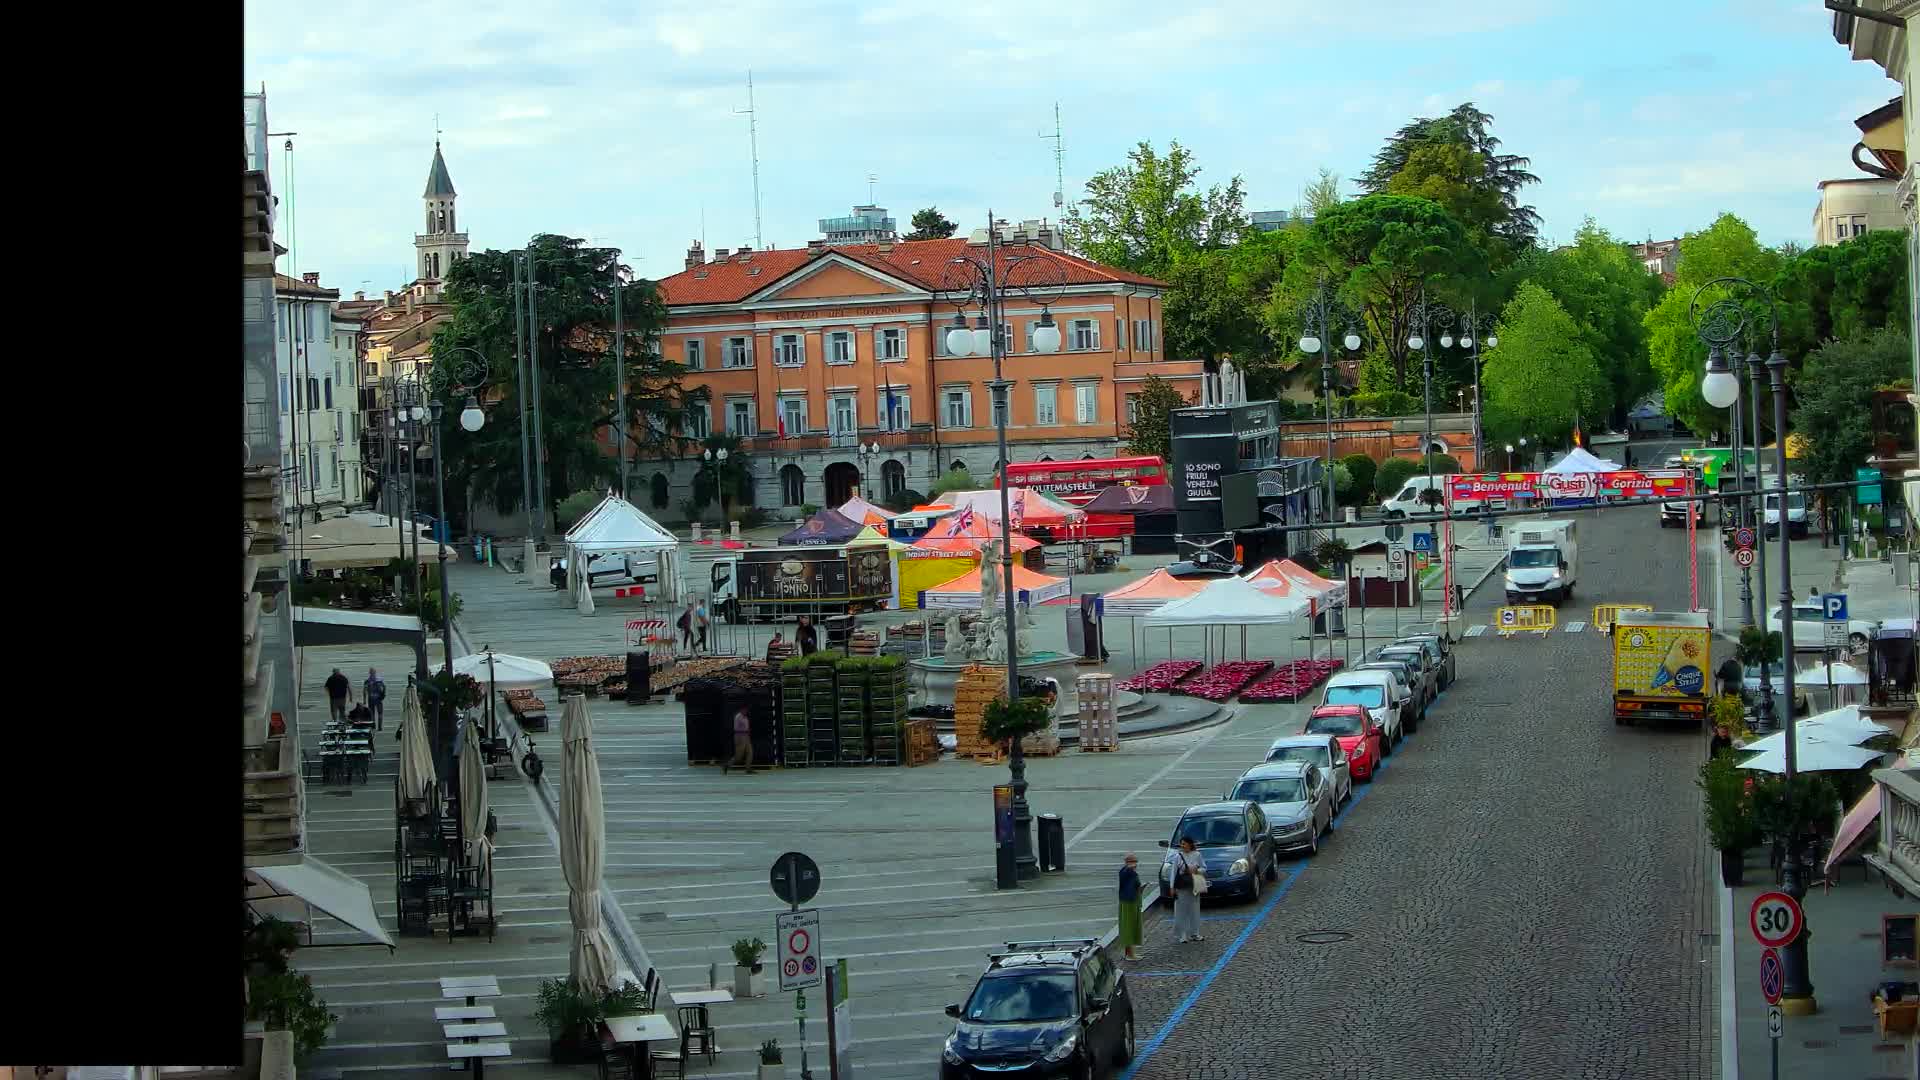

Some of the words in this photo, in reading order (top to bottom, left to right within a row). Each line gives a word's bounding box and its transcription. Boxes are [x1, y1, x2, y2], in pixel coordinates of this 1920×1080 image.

[1196, 463, 1221, 471] SONO
[1186, 472, 1208, 480] FRIULI
[1186, 480, 1219, 488] VENEZIA
[1472, 481, 1531, 492] Benvenuti
[1612, 478, 1652, 489] Gorizia
[1187, 489, 1213, 497] GIULIA
[1740, 553, 1751, 562] 20
[1827, 598, 1842, 618] P
[1676, 671, 1702, 681] CINQUE
[1679, 678, 1700, 687] STELLE
[1760, 907, 1790, 932] 30
